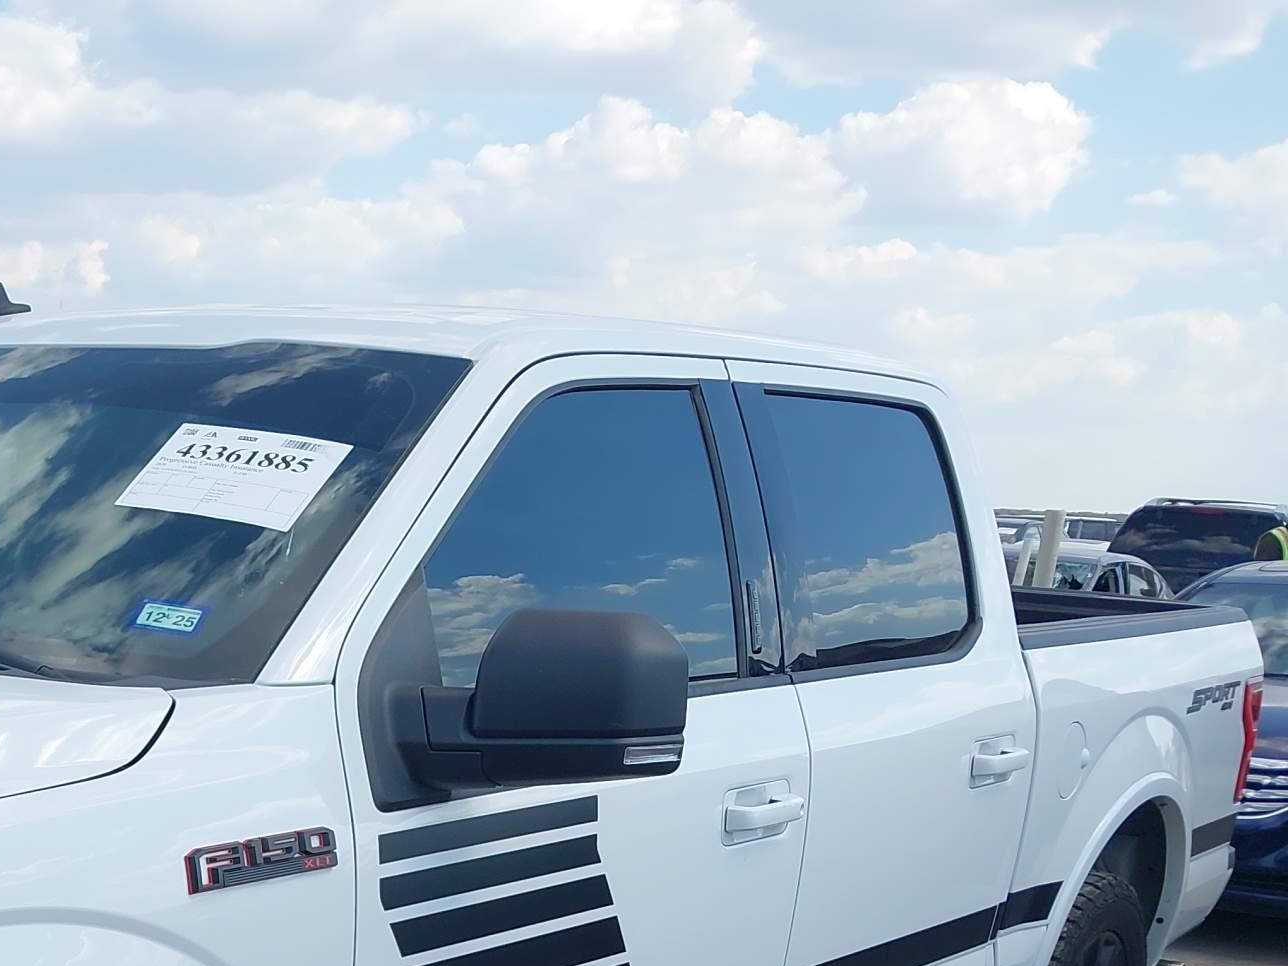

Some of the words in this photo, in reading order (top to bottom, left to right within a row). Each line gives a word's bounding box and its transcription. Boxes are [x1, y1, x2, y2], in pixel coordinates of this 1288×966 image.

[176, 443, 315, 473] 43361885
[145, 610, 166, 623] 12
[173, 614, 197, 628] 25
[1186, 680, 1242, 714] SPORT
